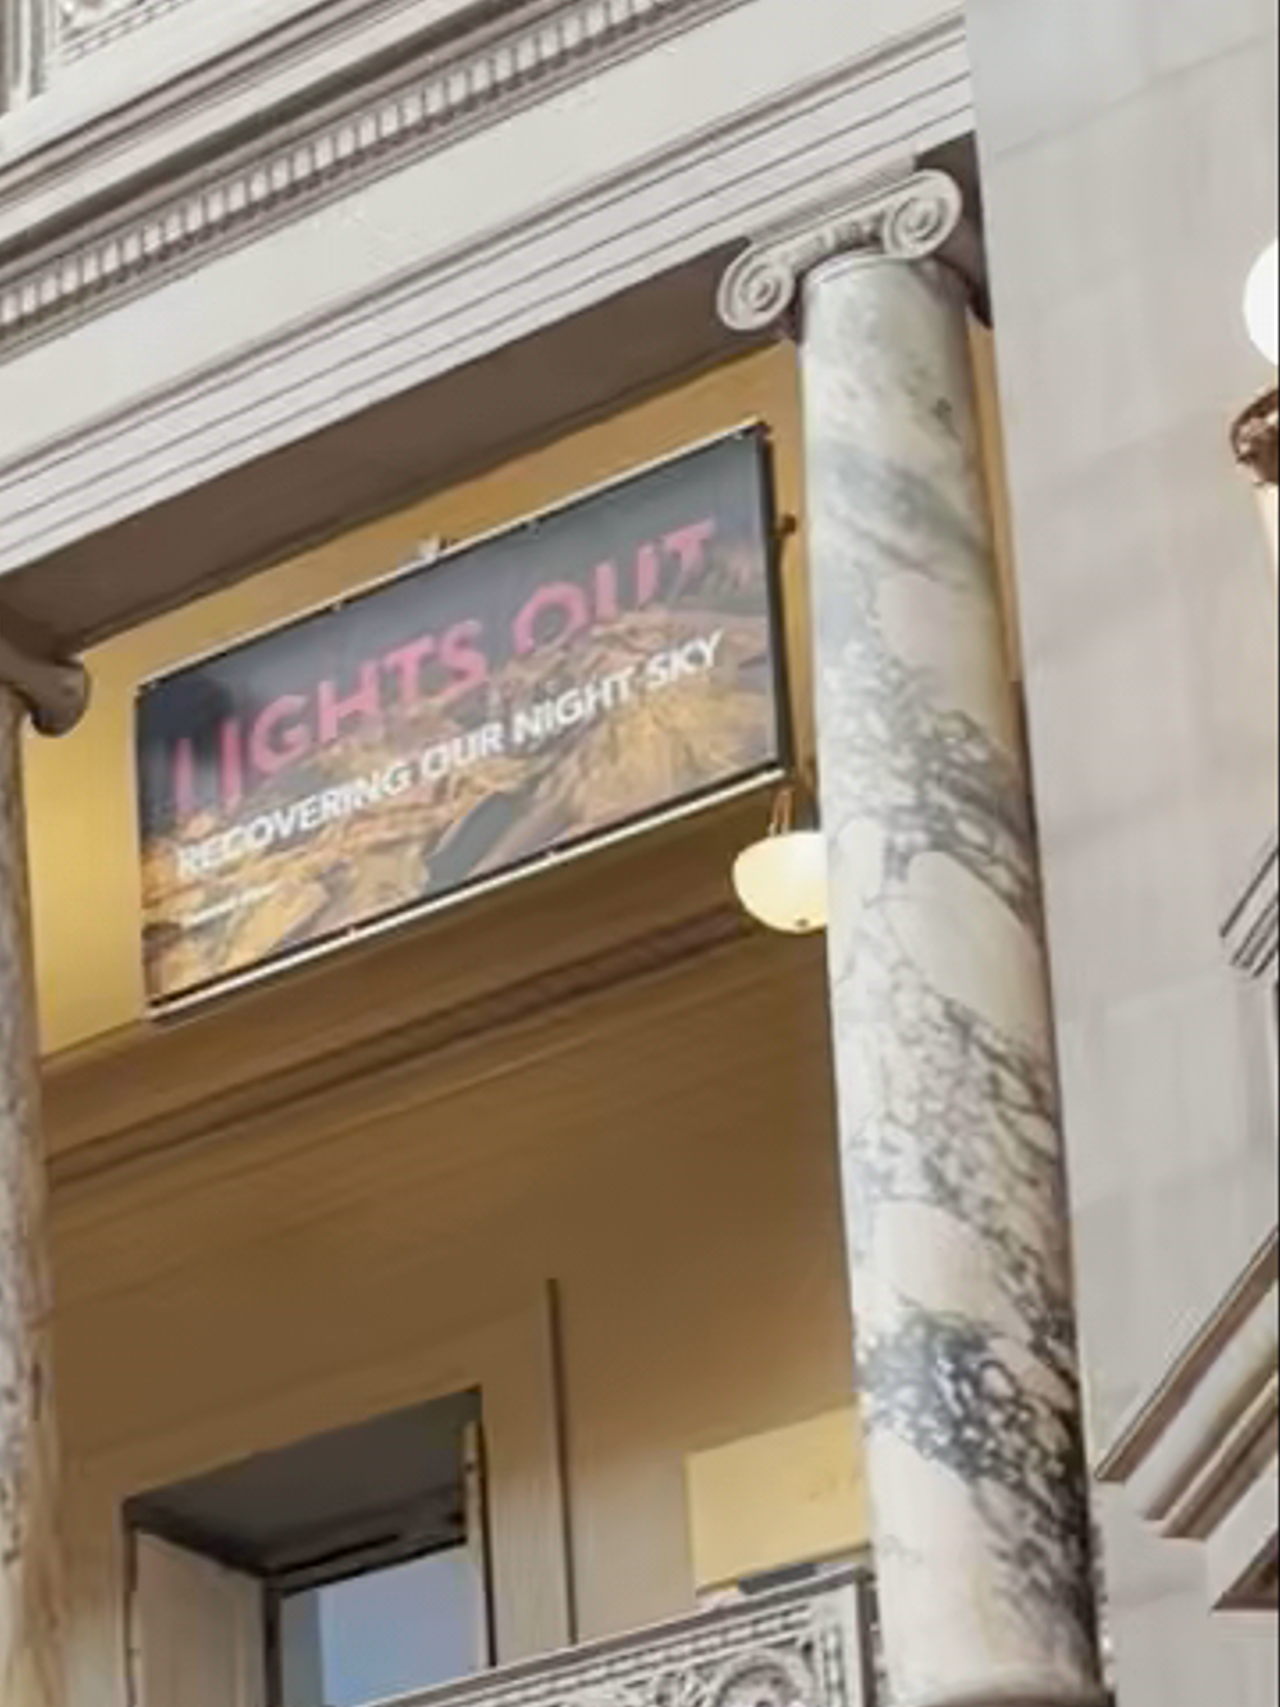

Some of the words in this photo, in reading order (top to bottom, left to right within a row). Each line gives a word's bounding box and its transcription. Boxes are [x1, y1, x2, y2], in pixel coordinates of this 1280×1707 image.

[173, 619, 492, 823] LIGHTS
[510, 516, 716, 657] OUT
[176, 759, 416, 879] RECOVERING
[419, 719, 507, 781] OUR
[510, 663, 637, 754] NIGHT
[642, 628, 726, 691] SKY
